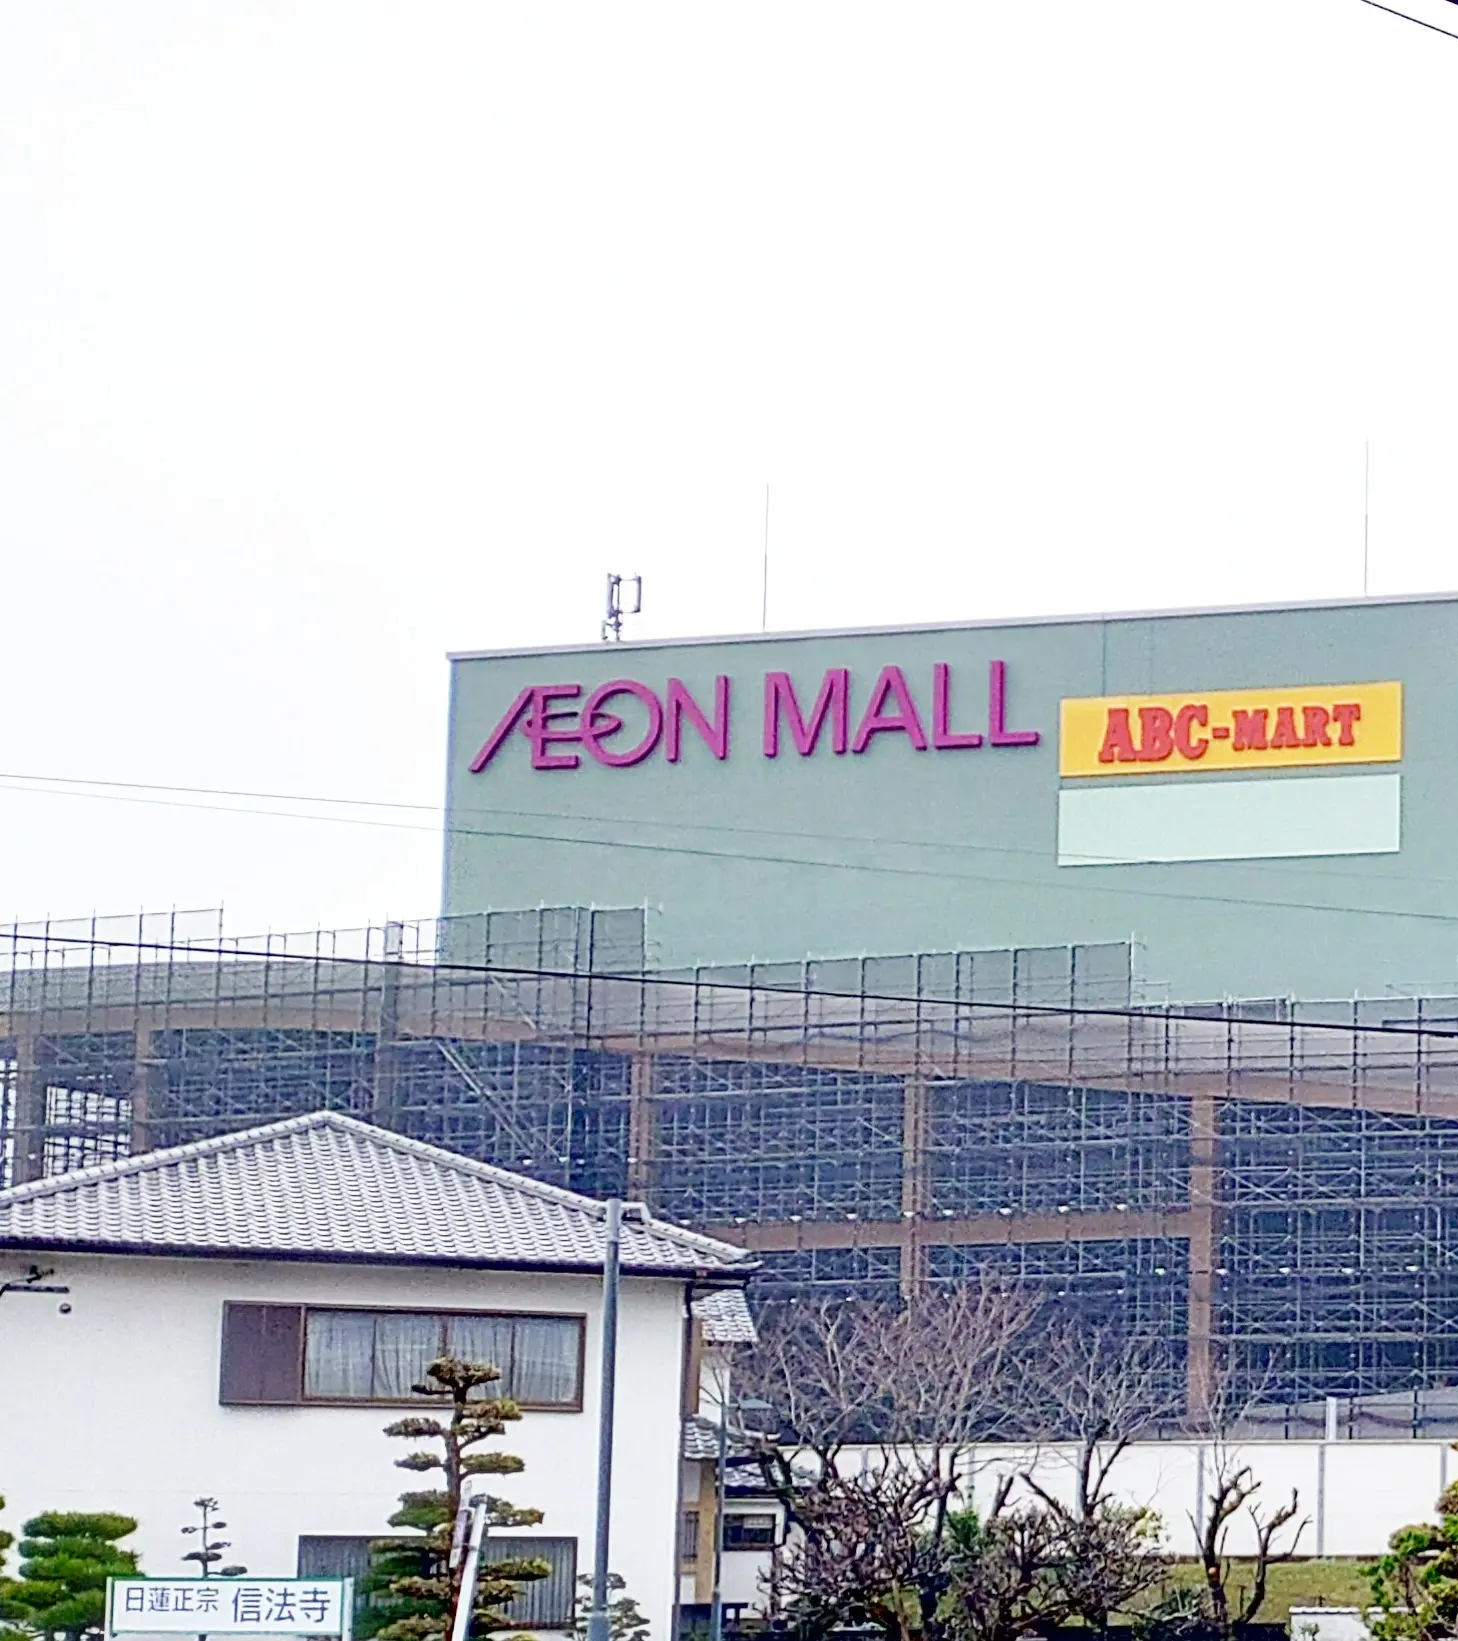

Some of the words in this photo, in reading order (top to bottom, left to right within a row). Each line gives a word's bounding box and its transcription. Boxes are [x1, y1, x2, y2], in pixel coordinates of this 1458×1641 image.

[763, 659, 1040, 758] MALL
[1098, 703, 1362, 763] ABC-MART
[125, 1586, 219, 1613] 日蓮正宗
[231, 1587, 331, 1624] 信法寺
